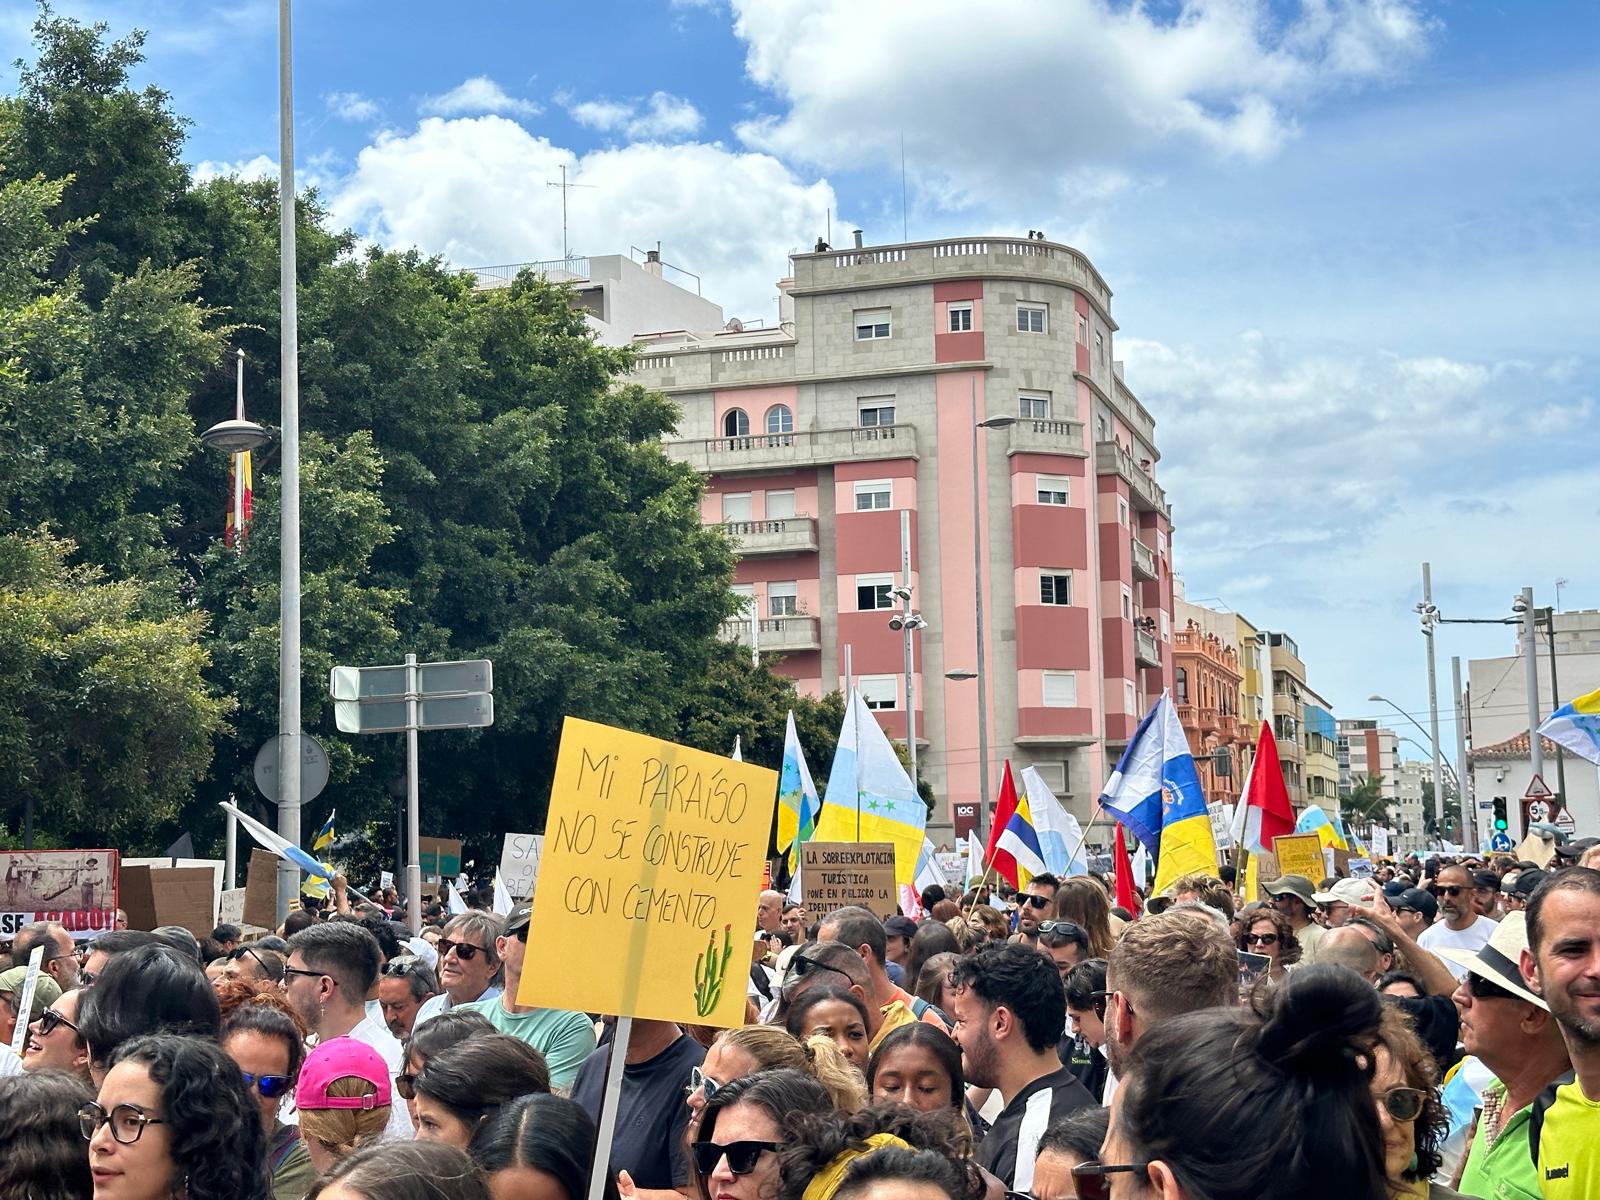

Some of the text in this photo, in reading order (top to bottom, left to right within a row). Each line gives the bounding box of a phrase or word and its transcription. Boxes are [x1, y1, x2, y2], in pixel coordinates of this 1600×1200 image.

[639, 757, 748, 824] PARAÍSO
[957, 806, 974, 814] IOC
[512, 835, 539, 860] SA
[553, 810, 597, 854] NO
[642, 824, 749, 882] CONSTRUYE
[806, 851, 818, 864] LA
[821, 869, 869, 885] TURÍSTICA
[564, 876, 717, 930] CON CEMENTO
[807, 889, 889, 899] PONE EN PELIGRO LA
[0, 914, 24, 934] SE
